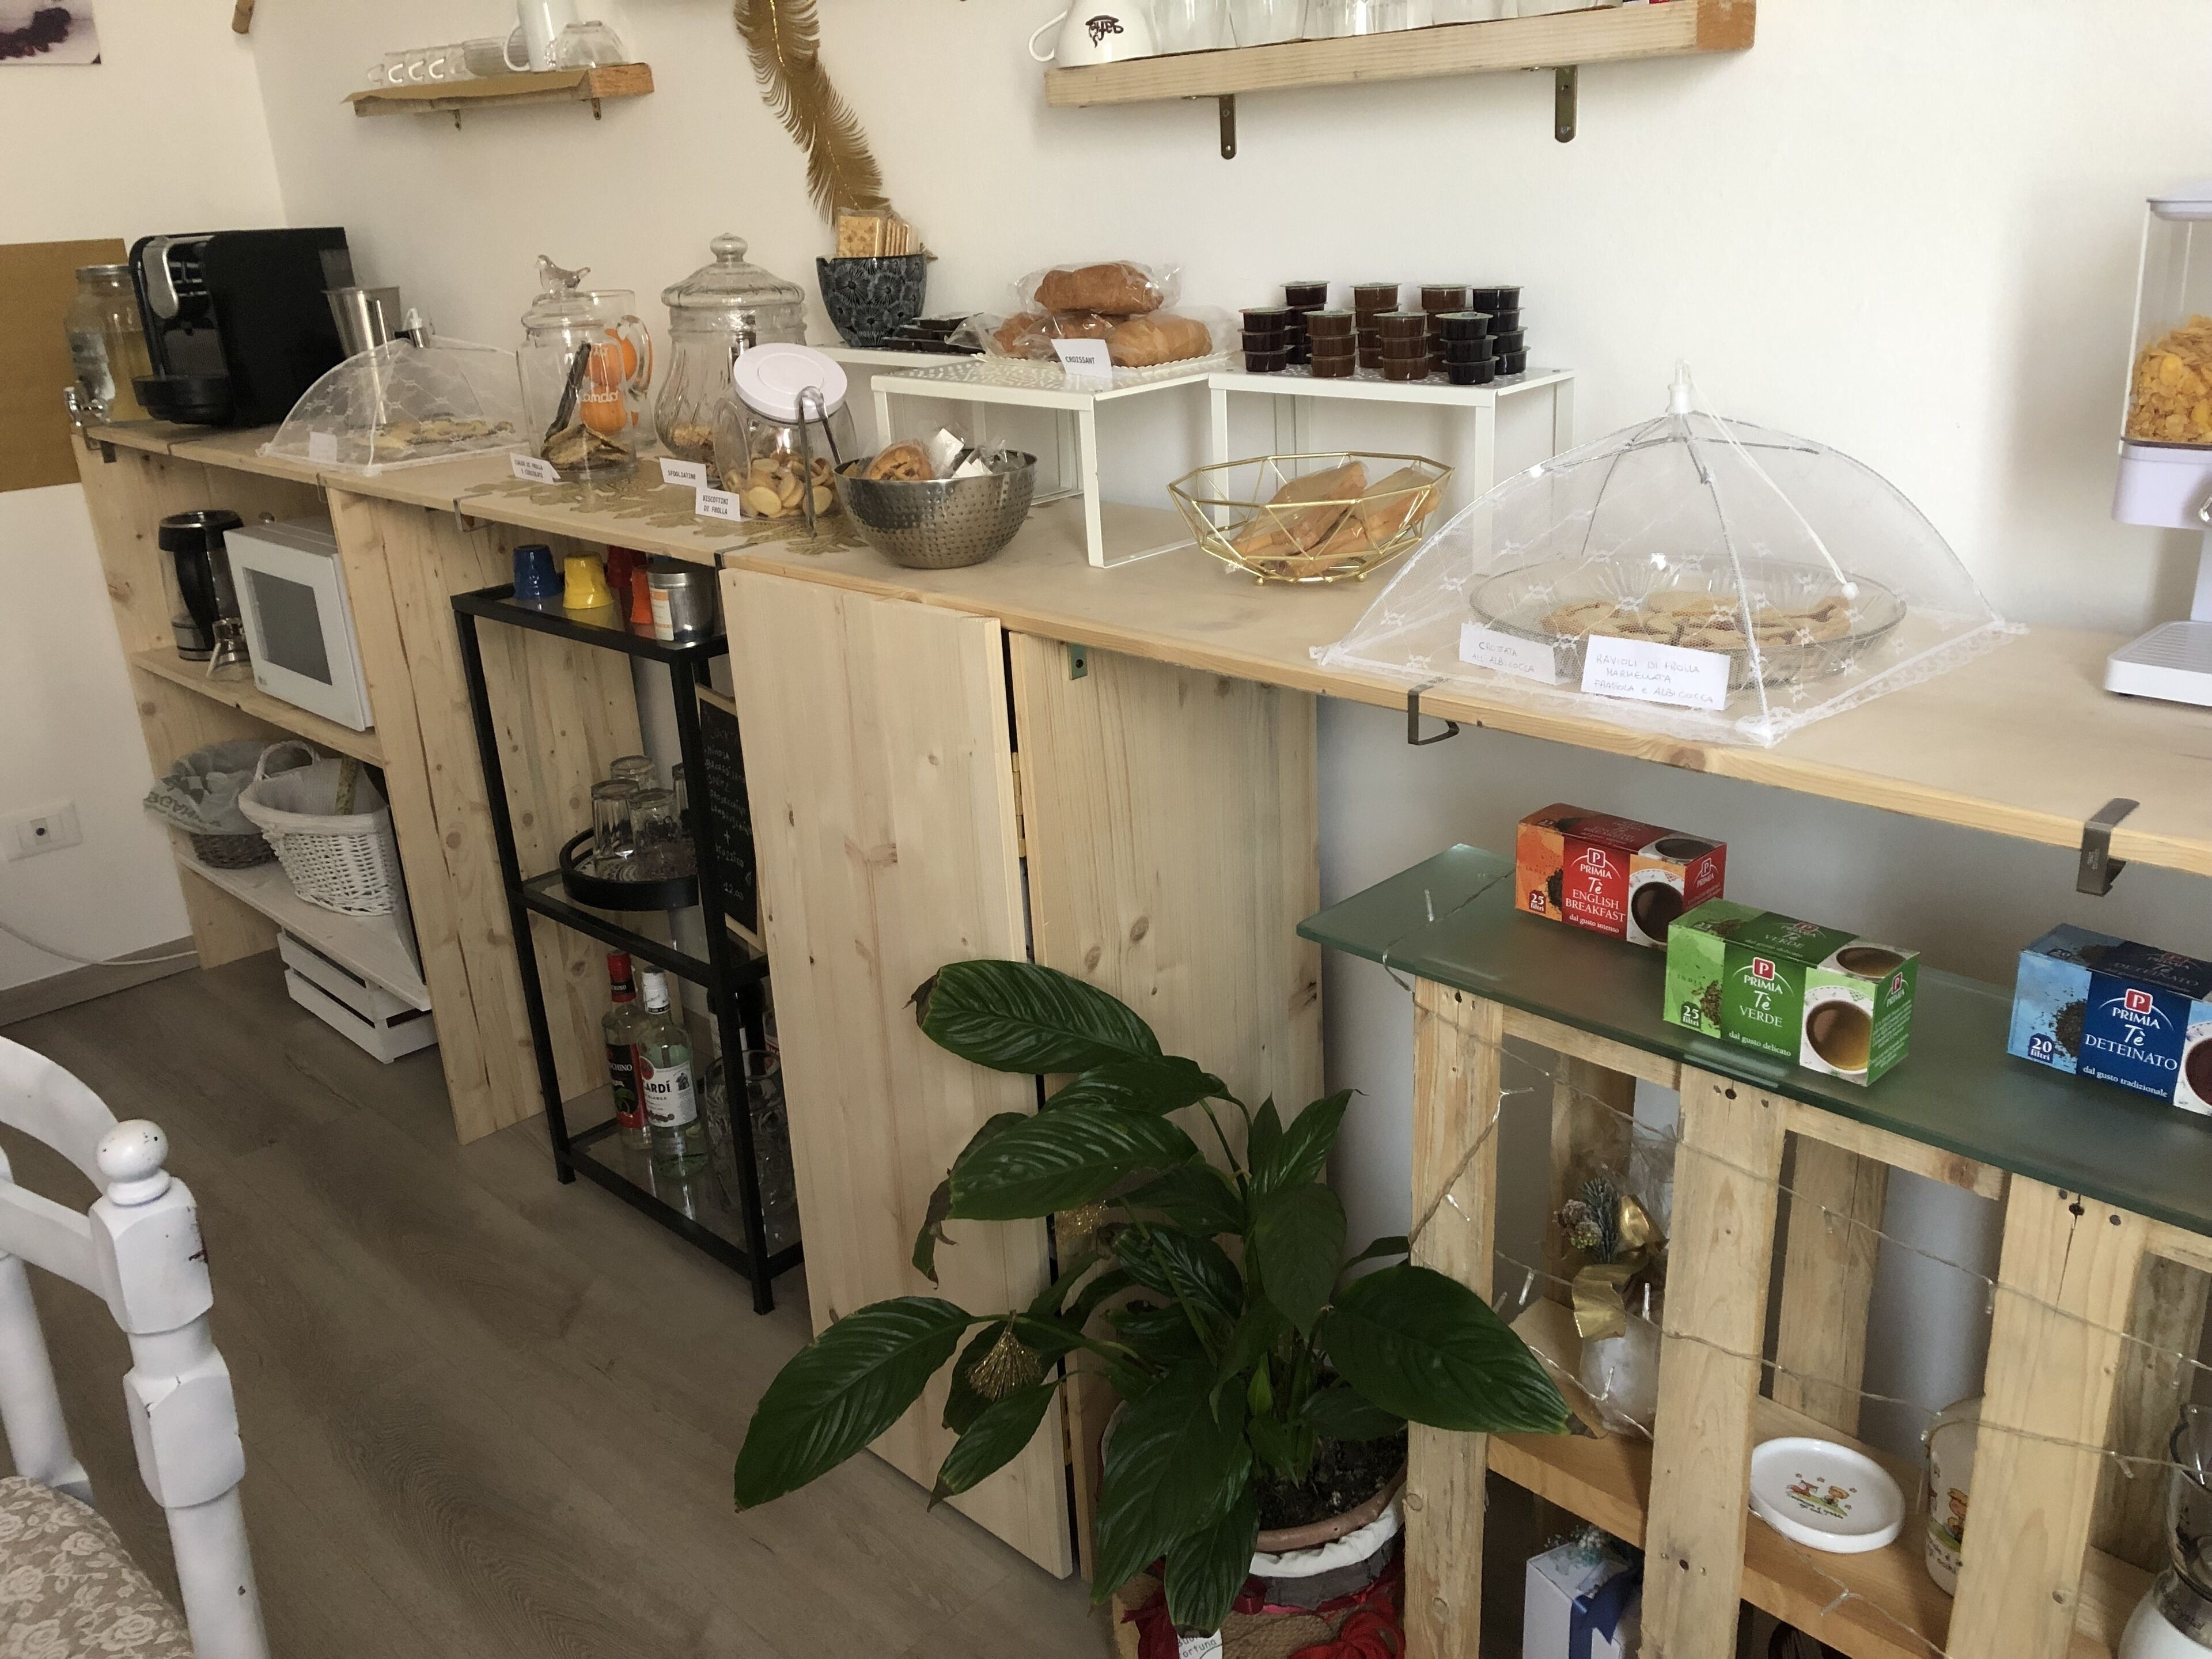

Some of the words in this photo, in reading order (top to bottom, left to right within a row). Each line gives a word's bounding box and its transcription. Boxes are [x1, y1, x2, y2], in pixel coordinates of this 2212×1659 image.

[1065, 356, 1095, 365] CROISSANT
[668, 470, 696, 480] SFOGLIATINE
[703, 495, 729, 505] BISCOTTINI
[711, 506, 728, 514] FROLLA
[1647, 661, 1658, 669] DI
[1594, 679, 1634, 691] FRAGOLA
[1580, 863, 1612, 880] PRIMIA
[1588, 877, 1603, 895] Tè
[1531, 893, 1544, 905] 25
[1531, 902, 1544, 912] filtri
[1573, 889, 1619, 910] ENGLISH
[1566, 898, 1626, 922] BREAKFAST
[1580, 917, 1596, 927] gusto
[1597, 922, 1619, 933] intenso
[1744, 975, 1783, 995] PRIMIA
[1754, 990, 1772, 1010] Tè
[1683, 1005, 1699, 1019] 25
[1739, 1005, 1783, 1028] VERDE
[2112, 1006, 2161, 1029] PRIMIA
[1683, 1016, 1699, 1027] filtri
[2124, 1024, 2145, 1047] Tè
[1729, 1031, 1740, 1040] dal
[1741, 1036, 1762, 1047] gusto
[1763, 1041, 1791, 1057] delicato
[2031, 1037, 2052, 1053] 20
[2030, 1048, 2051, 1061] filtri
[2084, 1034, 2178, 1071] DETEINATO
[2083, 1065, 2096, 1075] dal
[2096, 1070, 2119, 1083] gusto
[2120, 1077, 2168, 1098] tradizionale
[1179, 1640, 1217, 1659] ortuna
